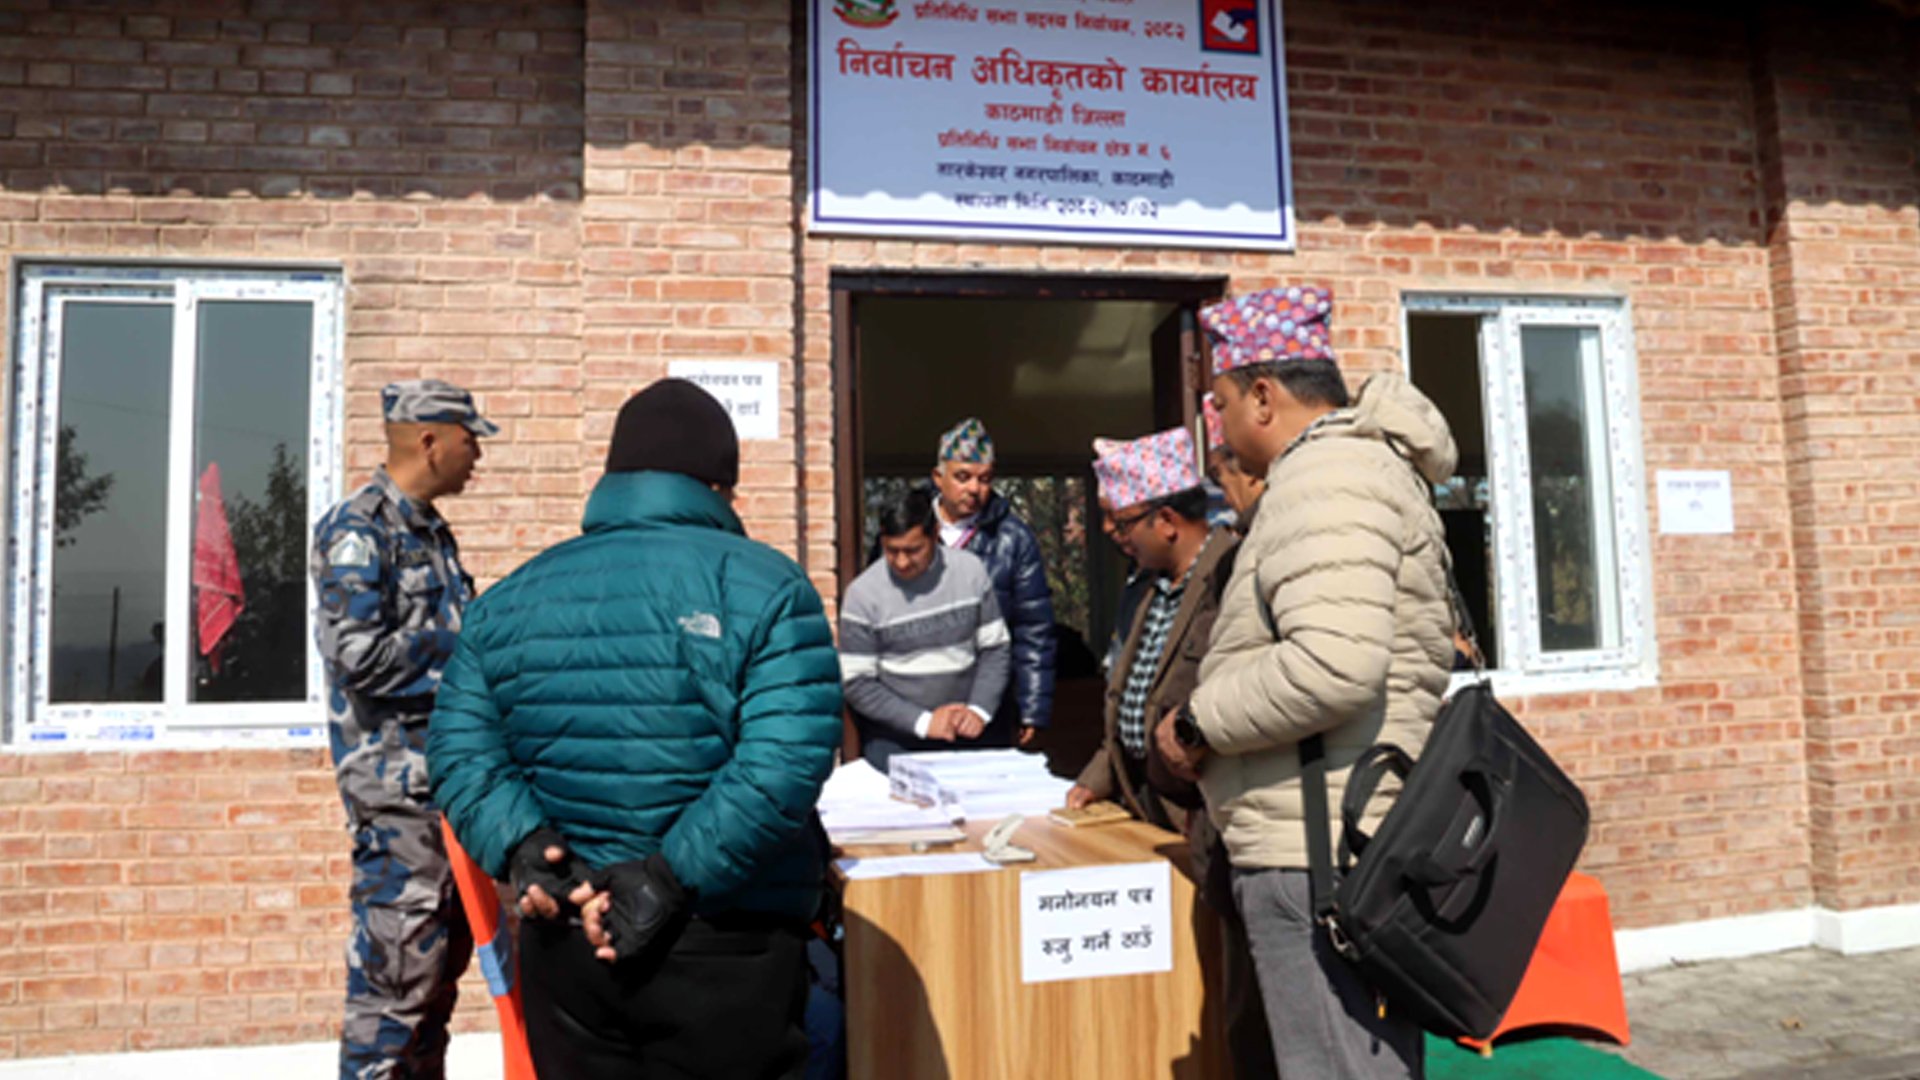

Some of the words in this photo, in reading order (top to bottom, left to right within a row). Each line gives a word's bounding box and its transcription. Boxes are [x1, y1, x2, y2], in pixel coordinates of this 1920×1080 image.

[985, 8, 1018, 25] सभा
[837, 38, 956, 81] निर्वाचन
[971, 47, 1127, 100] अधिकृतको
[1140, 62, 1259, 102] कार्यालय
[1038, 889, 1118, 912] मनोनयन
[1128, 888, 1154, 904] पत्र
[1082, 929, 1111, 952] गर्ने
[1121, 924, 1153, 949] ठाउँ
